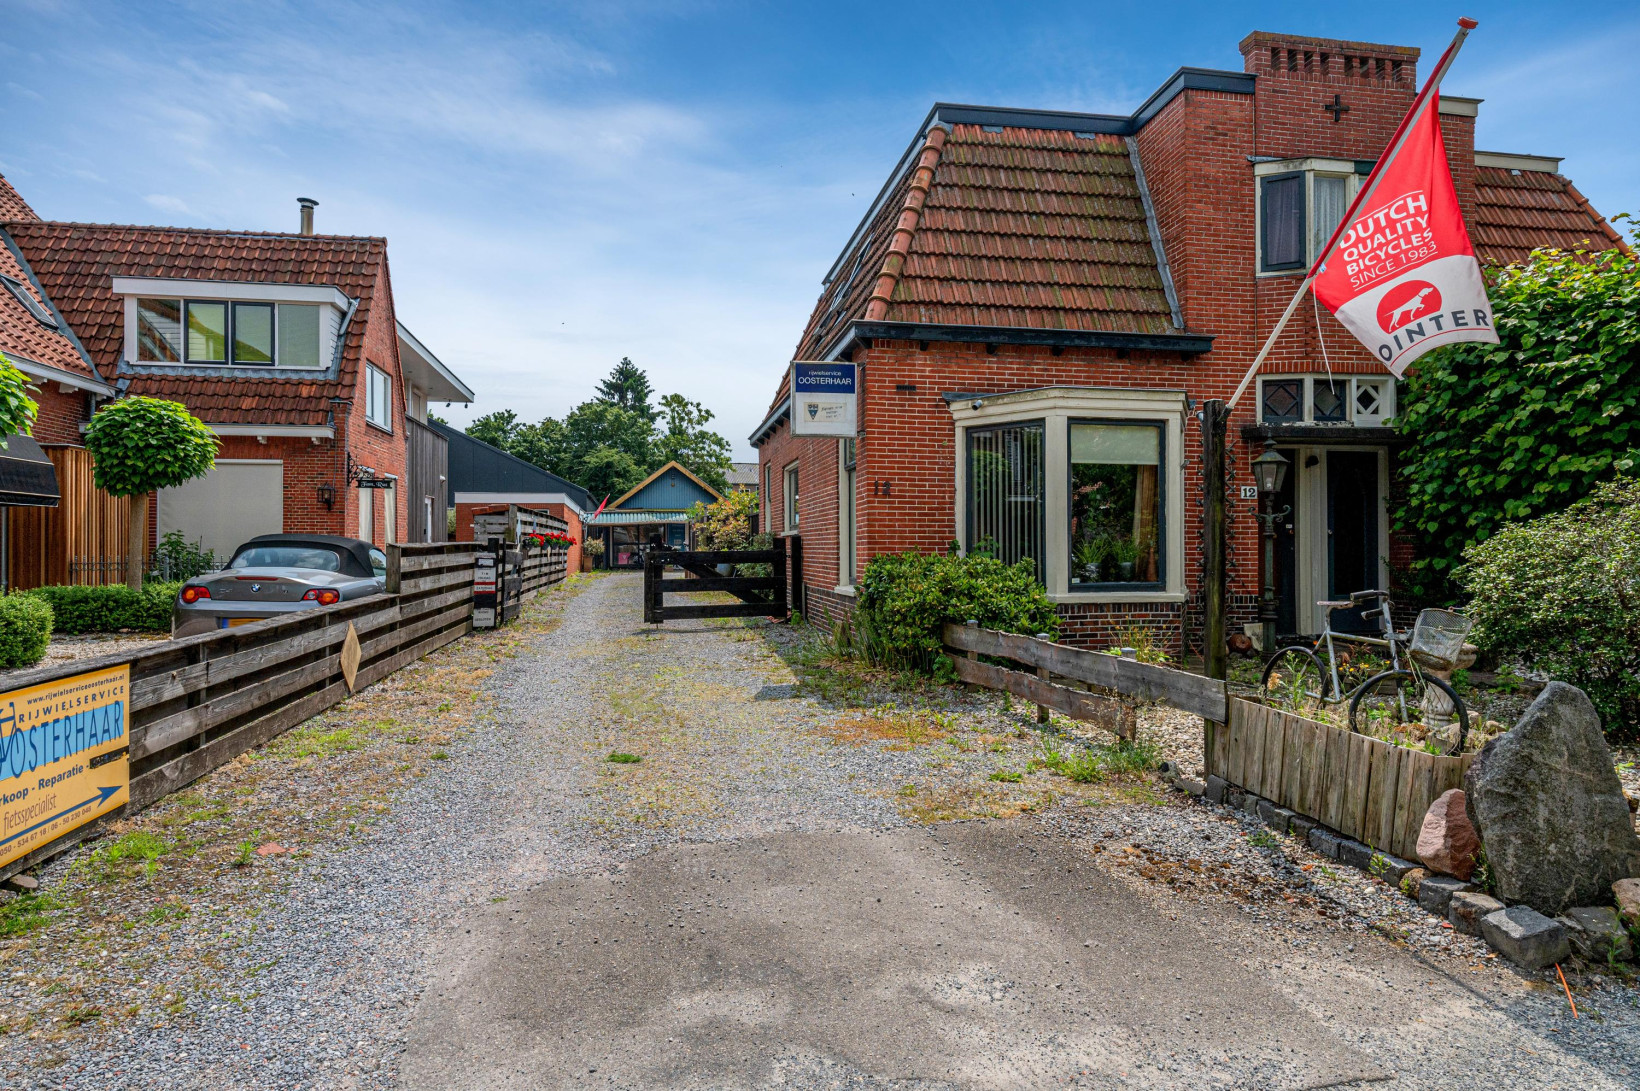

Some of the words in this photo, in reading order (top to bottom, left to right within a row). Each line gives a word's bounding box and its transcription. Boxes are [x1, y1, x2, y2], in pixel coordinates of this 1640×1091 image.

[1339, 194, 1428, 249] DUTCH
[1343, 213, 1429, 262] QUALITY
[1346, 228, 1433, 276] BICYCLES
[1350, 260, 1396, 288] SINCE
[1399, 241, 1437, 264] 1983
[798, 376, 852, 386] OOSTERHAAR
[1242, 487, 1256, 498] 12
[18, 685, 124, 724] RIJWIELSERVICE
[27, 674, 125, 706] www.rijwielserviceoosterhaar.nl
[0, 700, 122, 779] OSTERHAAR
[38, 763, 84, 791] Reparatie
[4, 793, 57, 836] fietsspecialist
